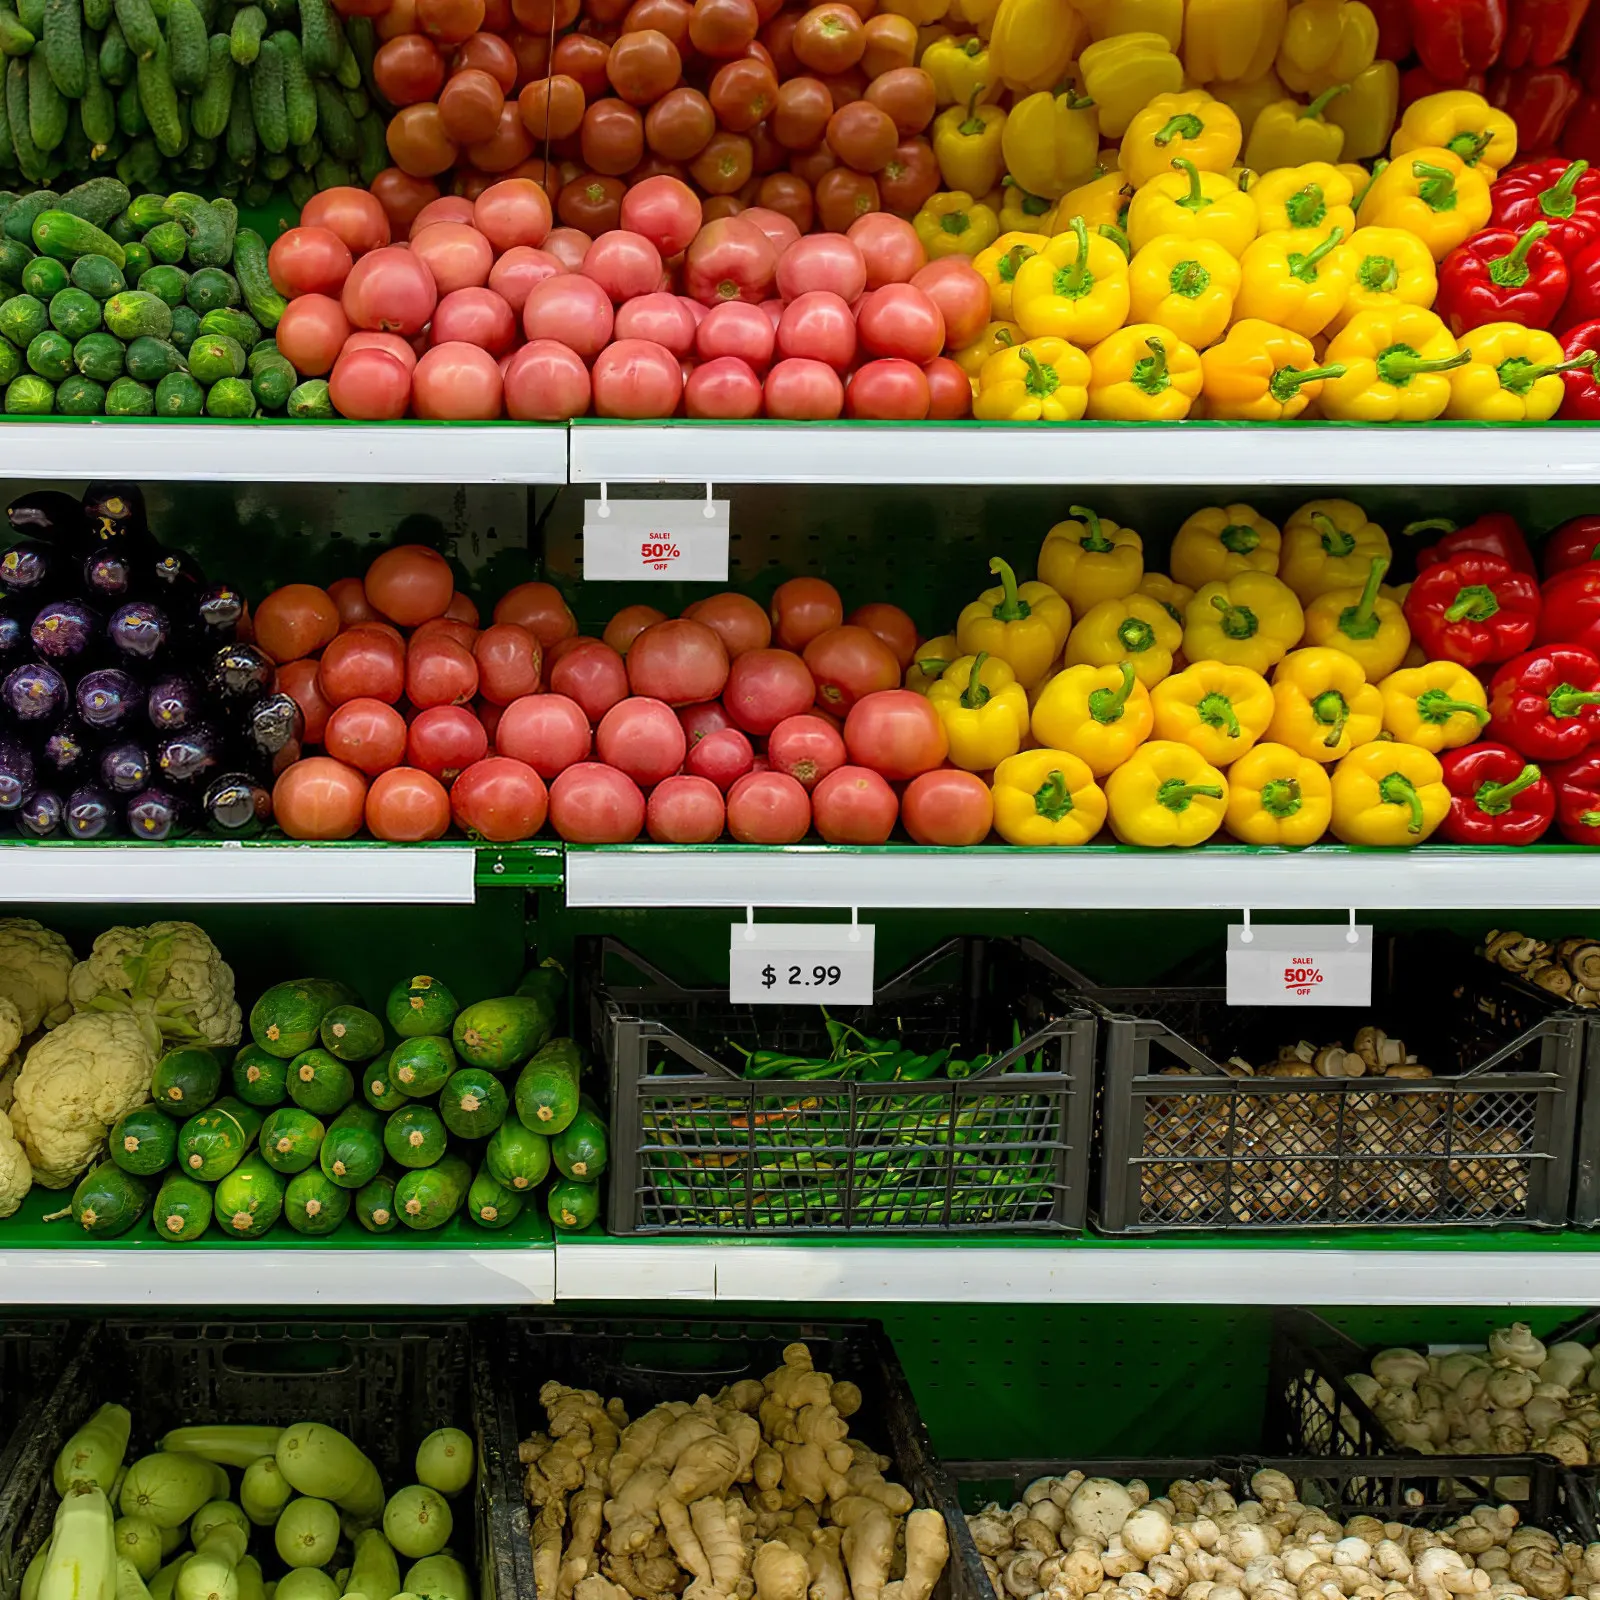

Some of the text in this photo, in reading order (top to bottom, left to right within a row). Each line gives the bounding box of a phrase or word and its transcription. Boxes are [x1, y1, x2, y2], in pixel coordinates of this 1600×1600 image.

[641, 543, 680, 558] 50%
[761, 964, 841, 989] $ 2.99
[1284, 968, 1323, 983] 50%
